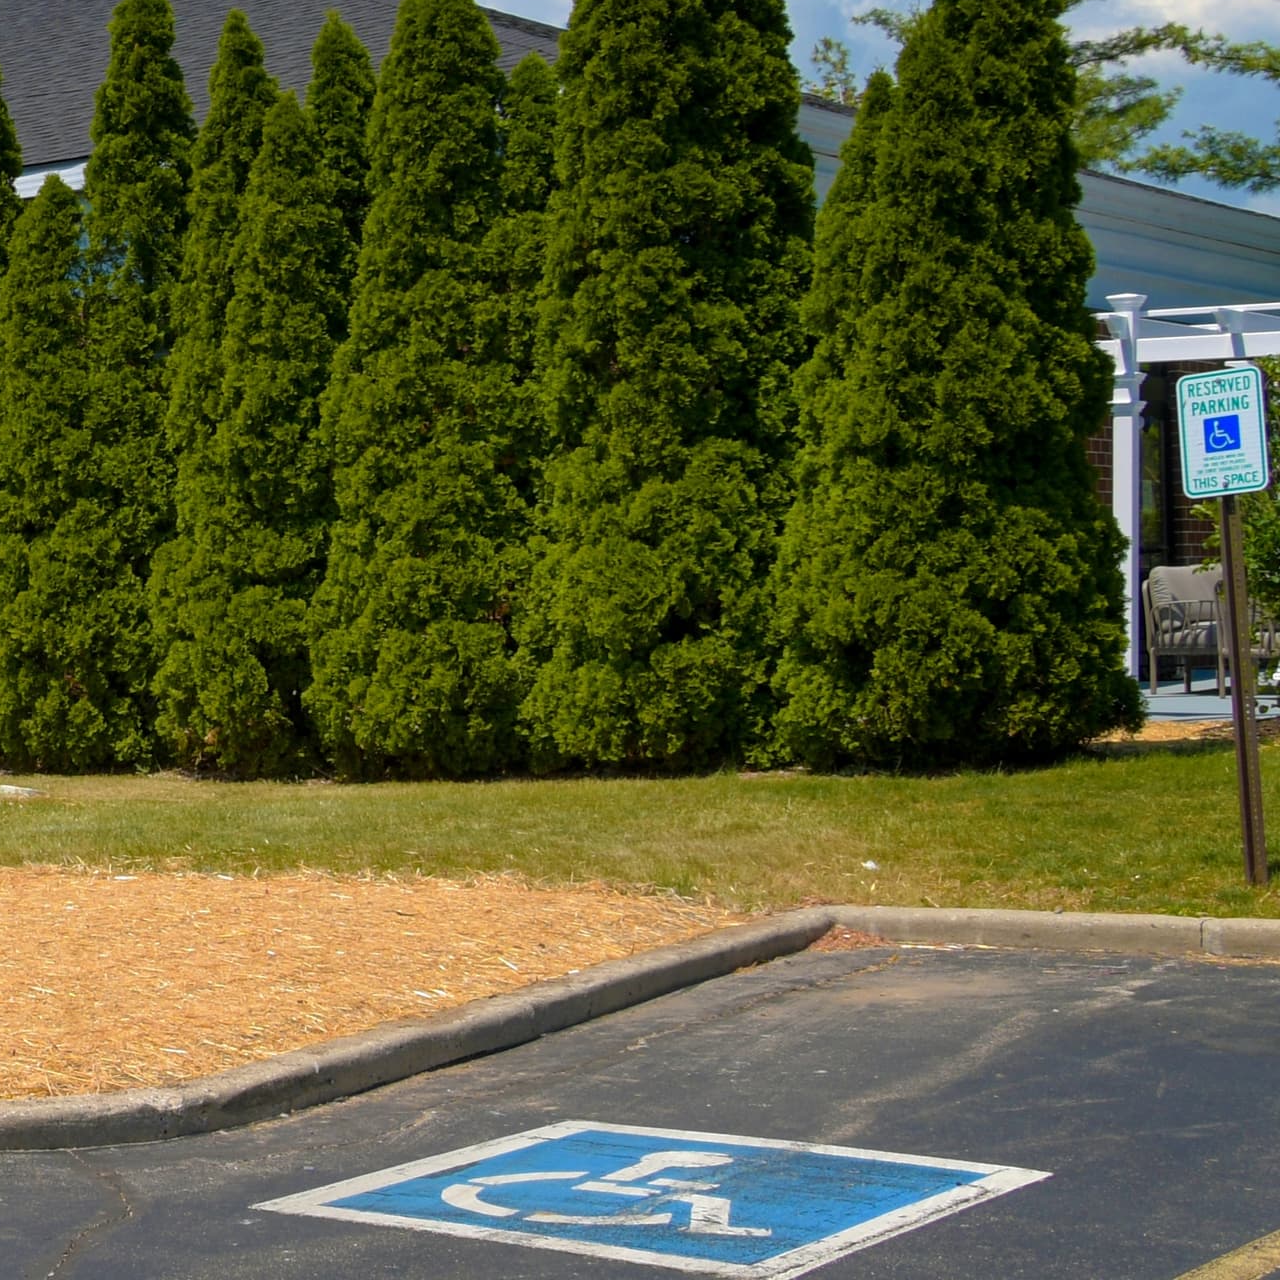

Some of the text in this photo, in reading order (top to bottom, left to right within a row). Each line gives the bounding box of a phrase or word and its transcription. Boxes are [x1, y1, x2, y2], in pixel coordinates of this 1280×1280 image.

[1188, 375, 1250, 398] RESERVED
[1192, 395, 1249, 416] PARKING
[1192, 470, 1259, 489] THIS SPACE
